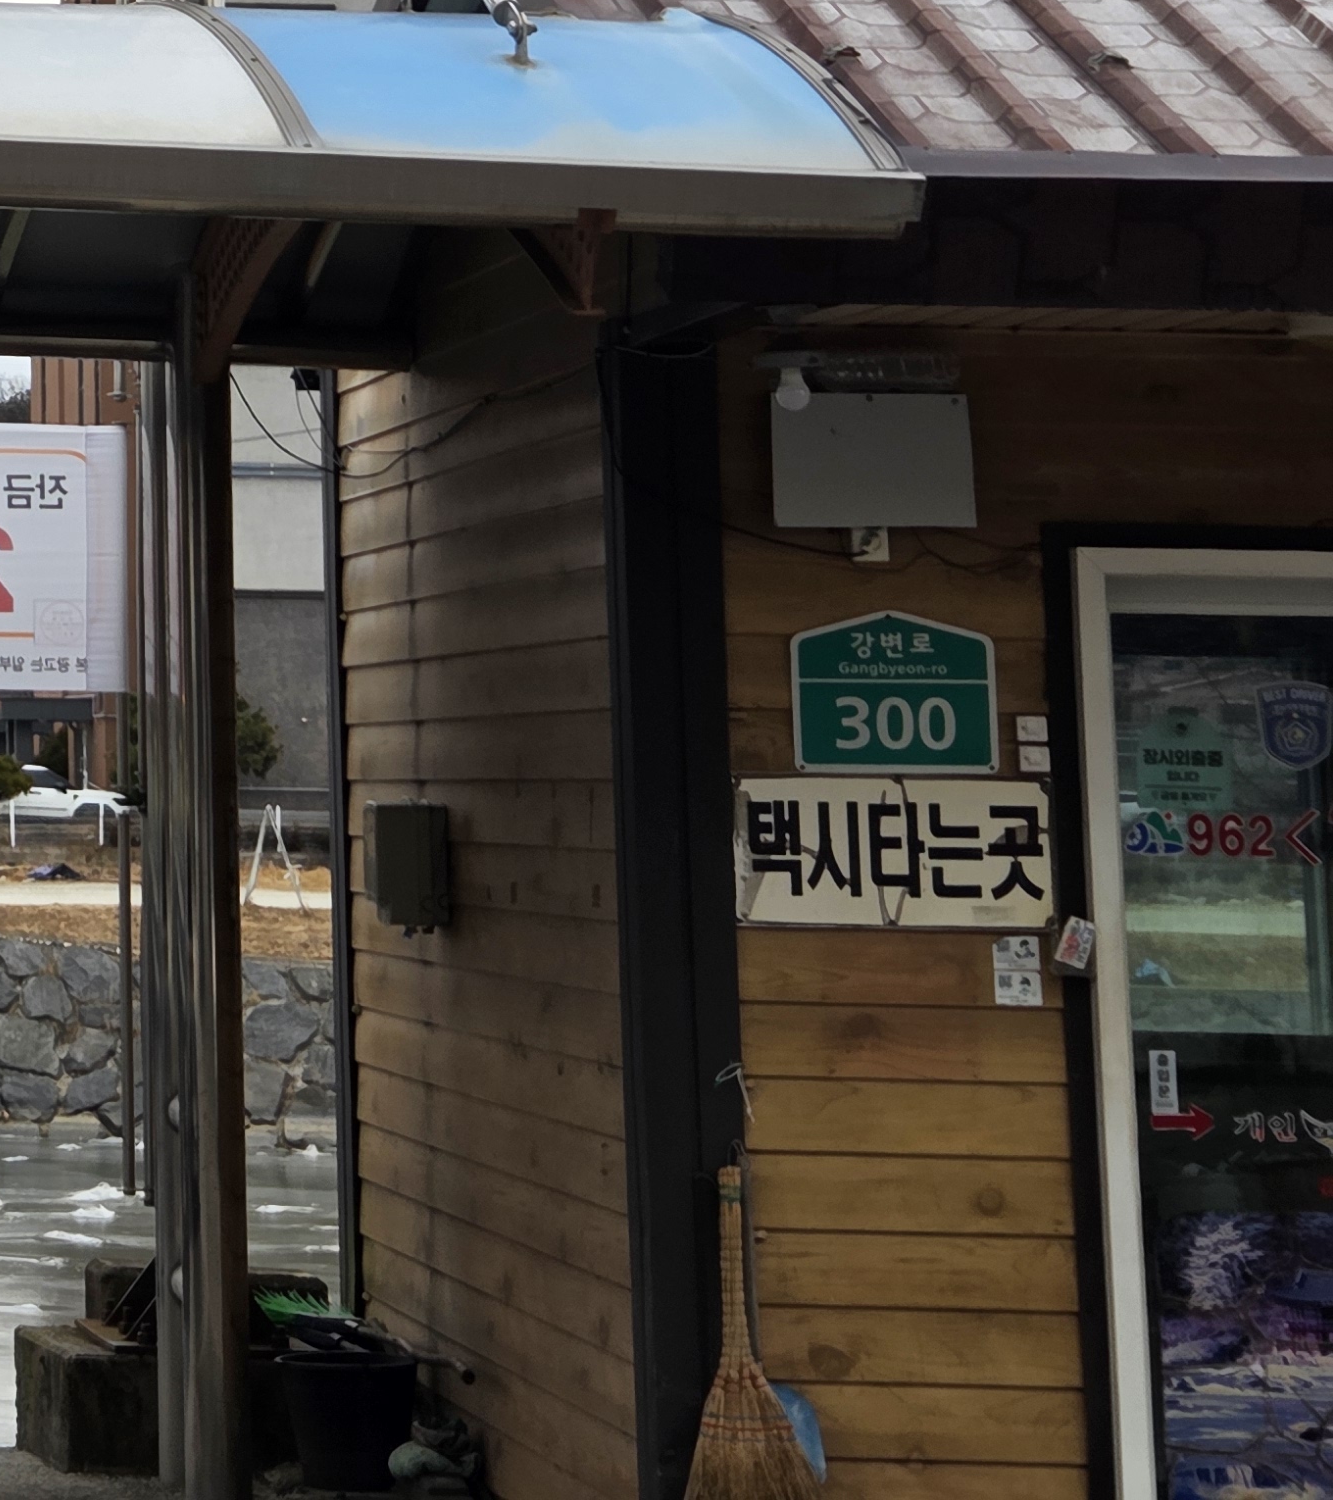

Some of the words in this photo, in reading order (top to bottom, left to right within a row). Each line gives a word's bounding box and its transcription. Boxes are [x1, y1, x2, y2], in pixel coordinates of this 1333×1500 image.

[850, 631, 935, 659] 강변로
[838, 661, 948, 677] Gangbyeon-ro
[834, 696, 956, 751] 300
[746, 799, 1046, 902] 택시타는곳
[1188, 812, 1276, 857] 962
[1232, 1110, 1299, 1143] 개인
